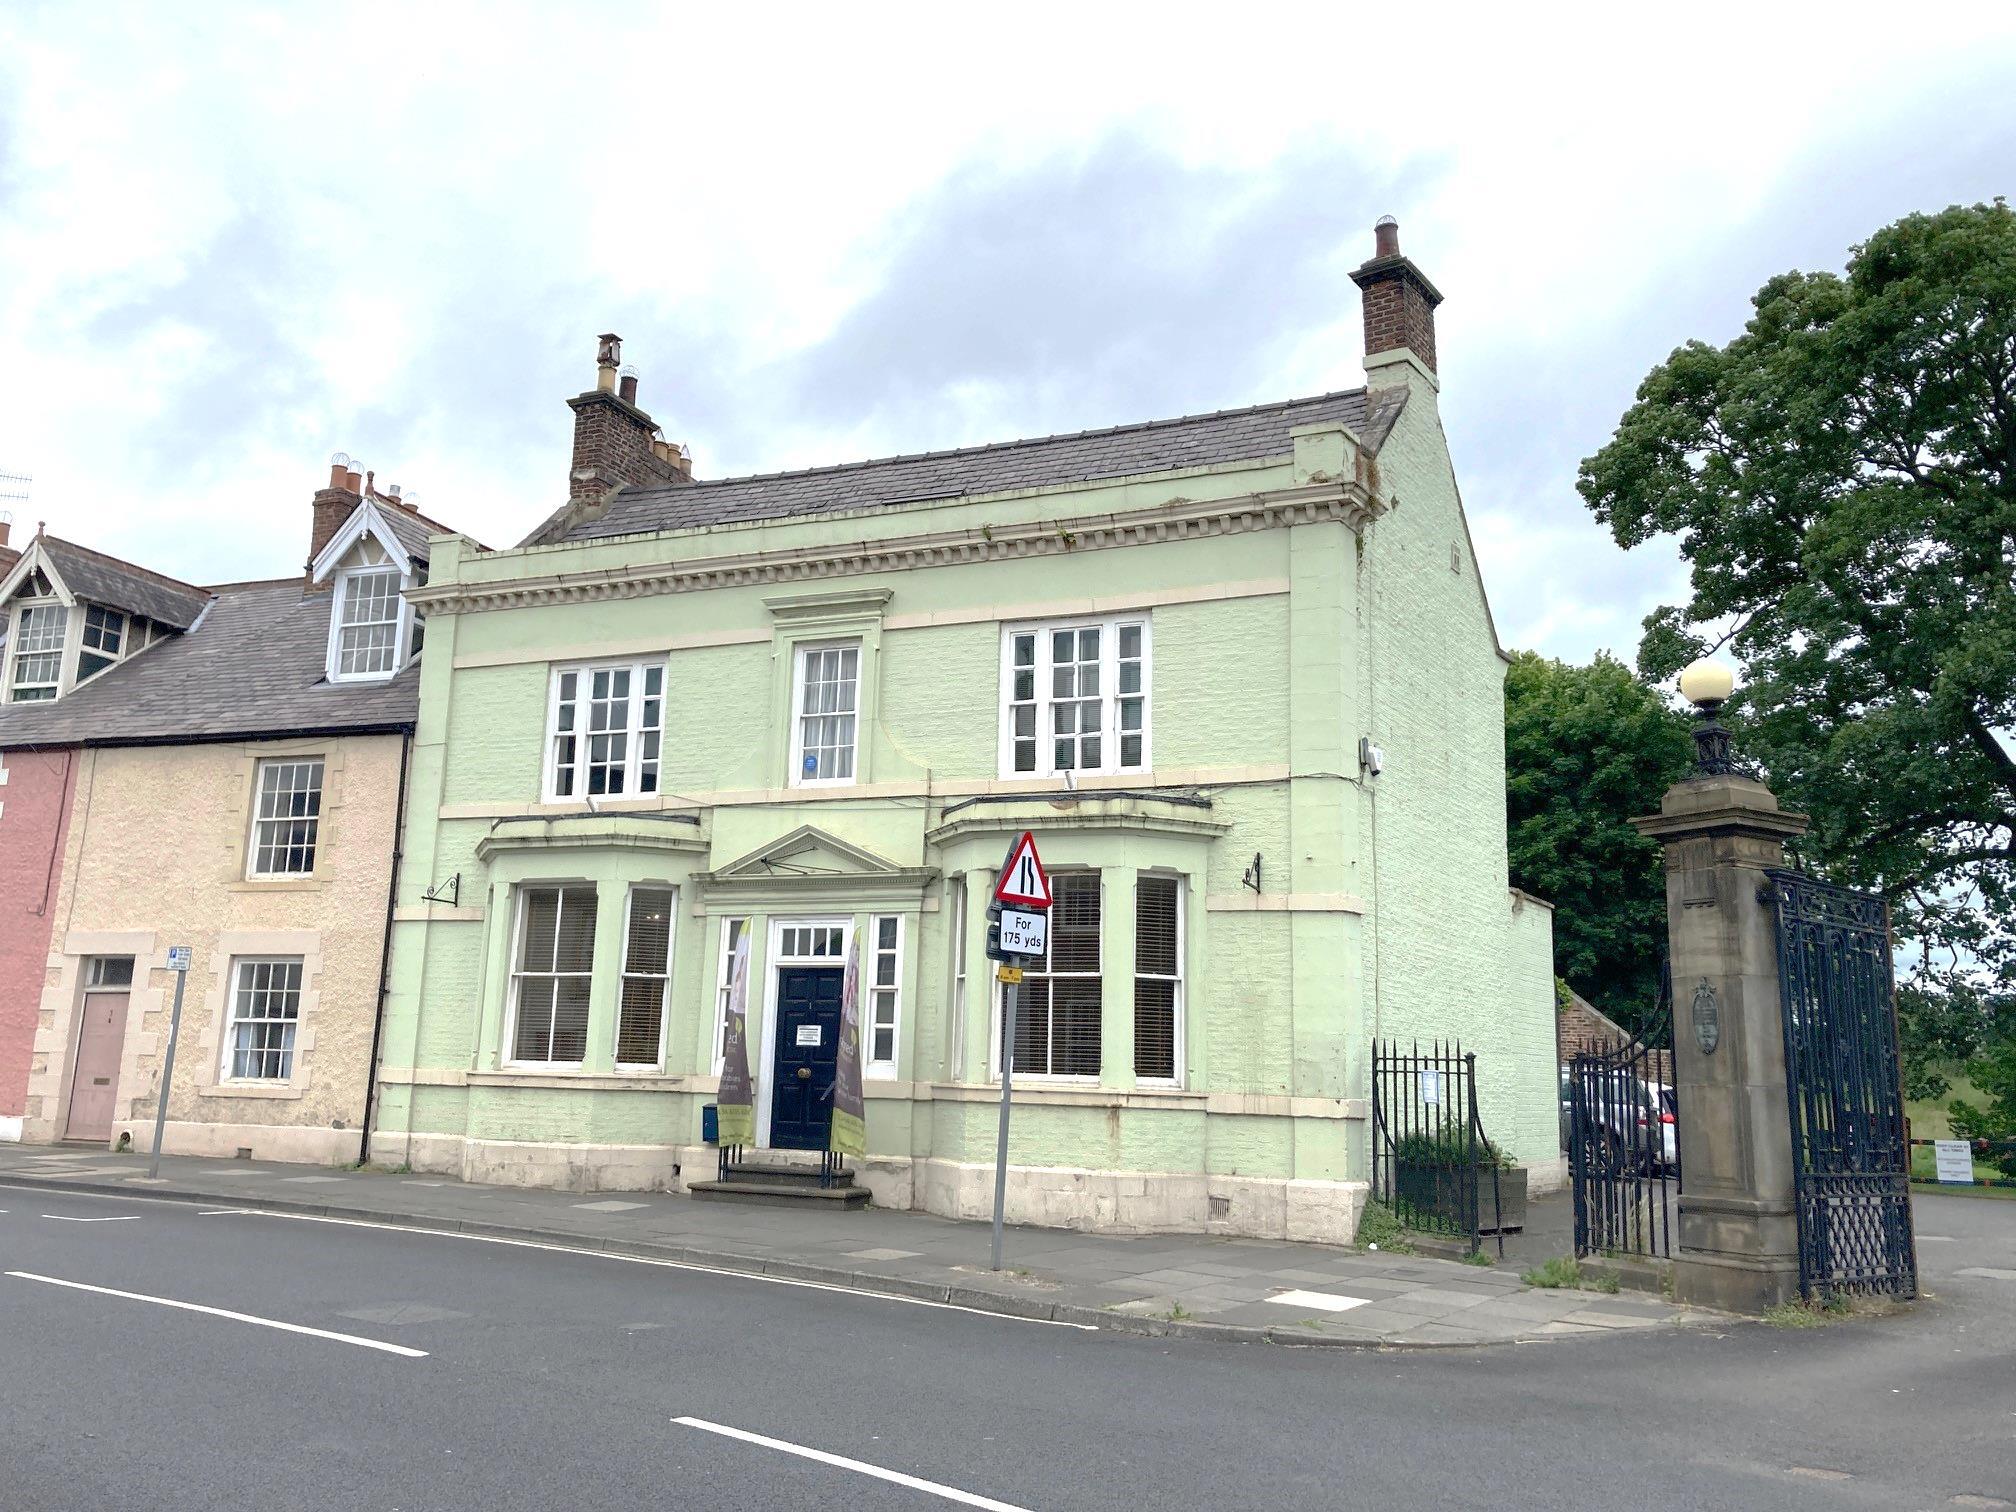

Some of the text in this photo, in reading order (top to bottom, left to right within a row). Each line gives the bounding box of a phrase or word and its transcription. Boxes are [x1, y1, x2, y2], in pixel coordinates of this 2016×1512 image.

[1015, 916, 1031, 930] For
[1004, 931, 1042, 948] 175 yds
